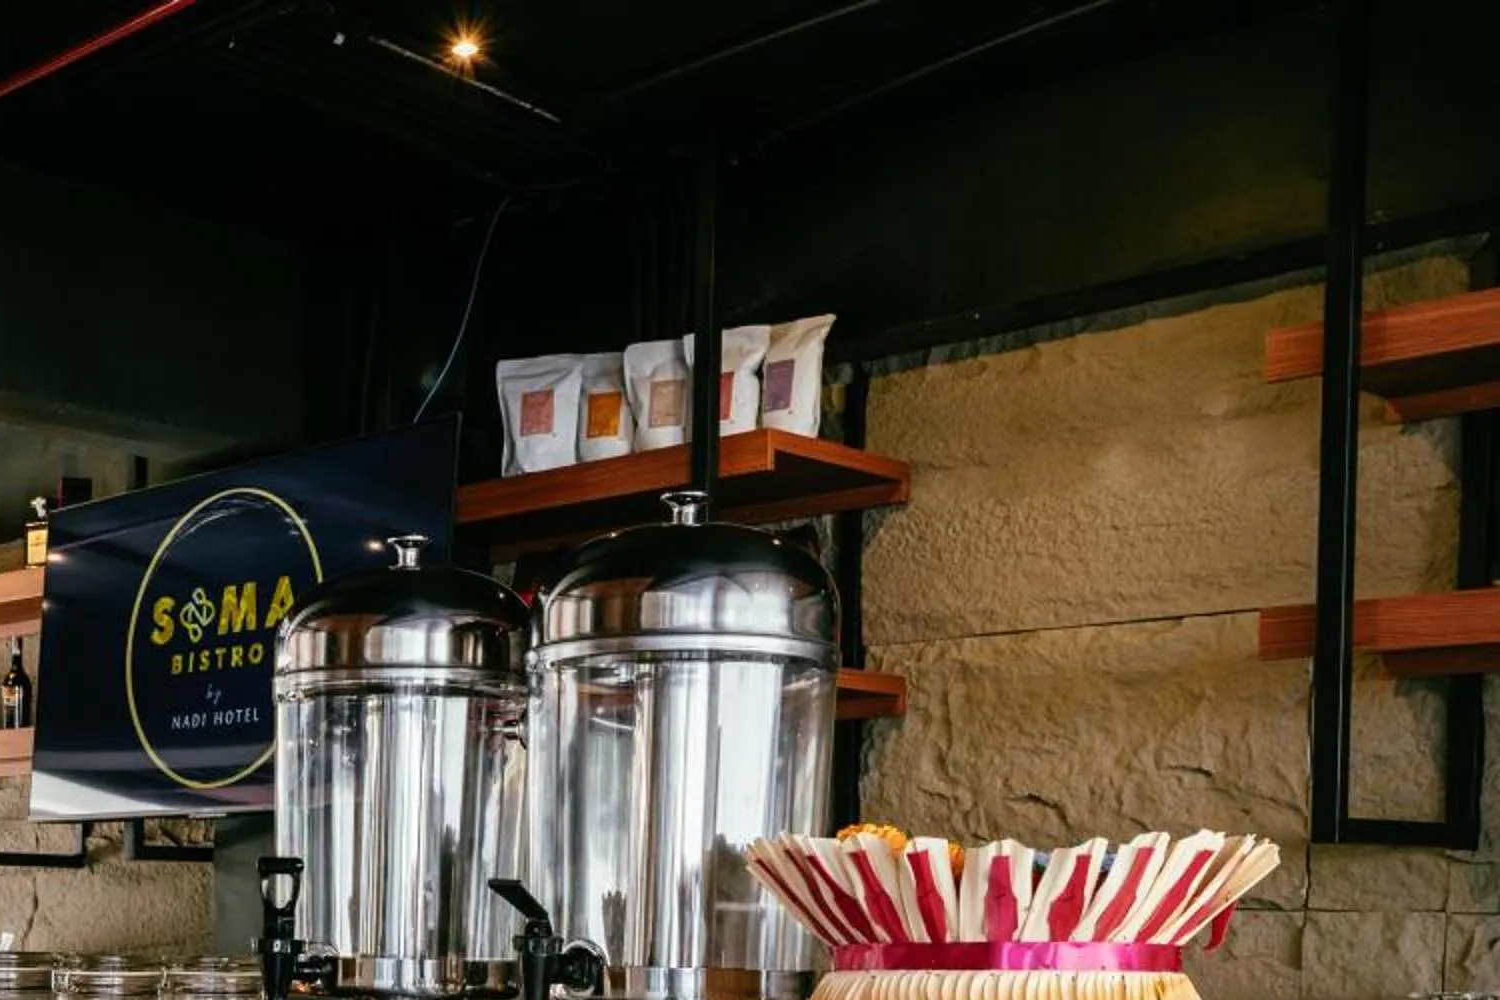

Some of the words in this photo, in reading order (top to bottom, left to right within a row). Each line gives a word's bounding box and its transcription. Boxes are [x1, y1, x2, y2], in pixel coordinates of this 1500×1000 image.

[170, 642, 264, 675] BISTRO
[205, 682, 222, 705] by
[171, 711, 207, 730] NADI
[213, 706, 260, 726] HOTEL
